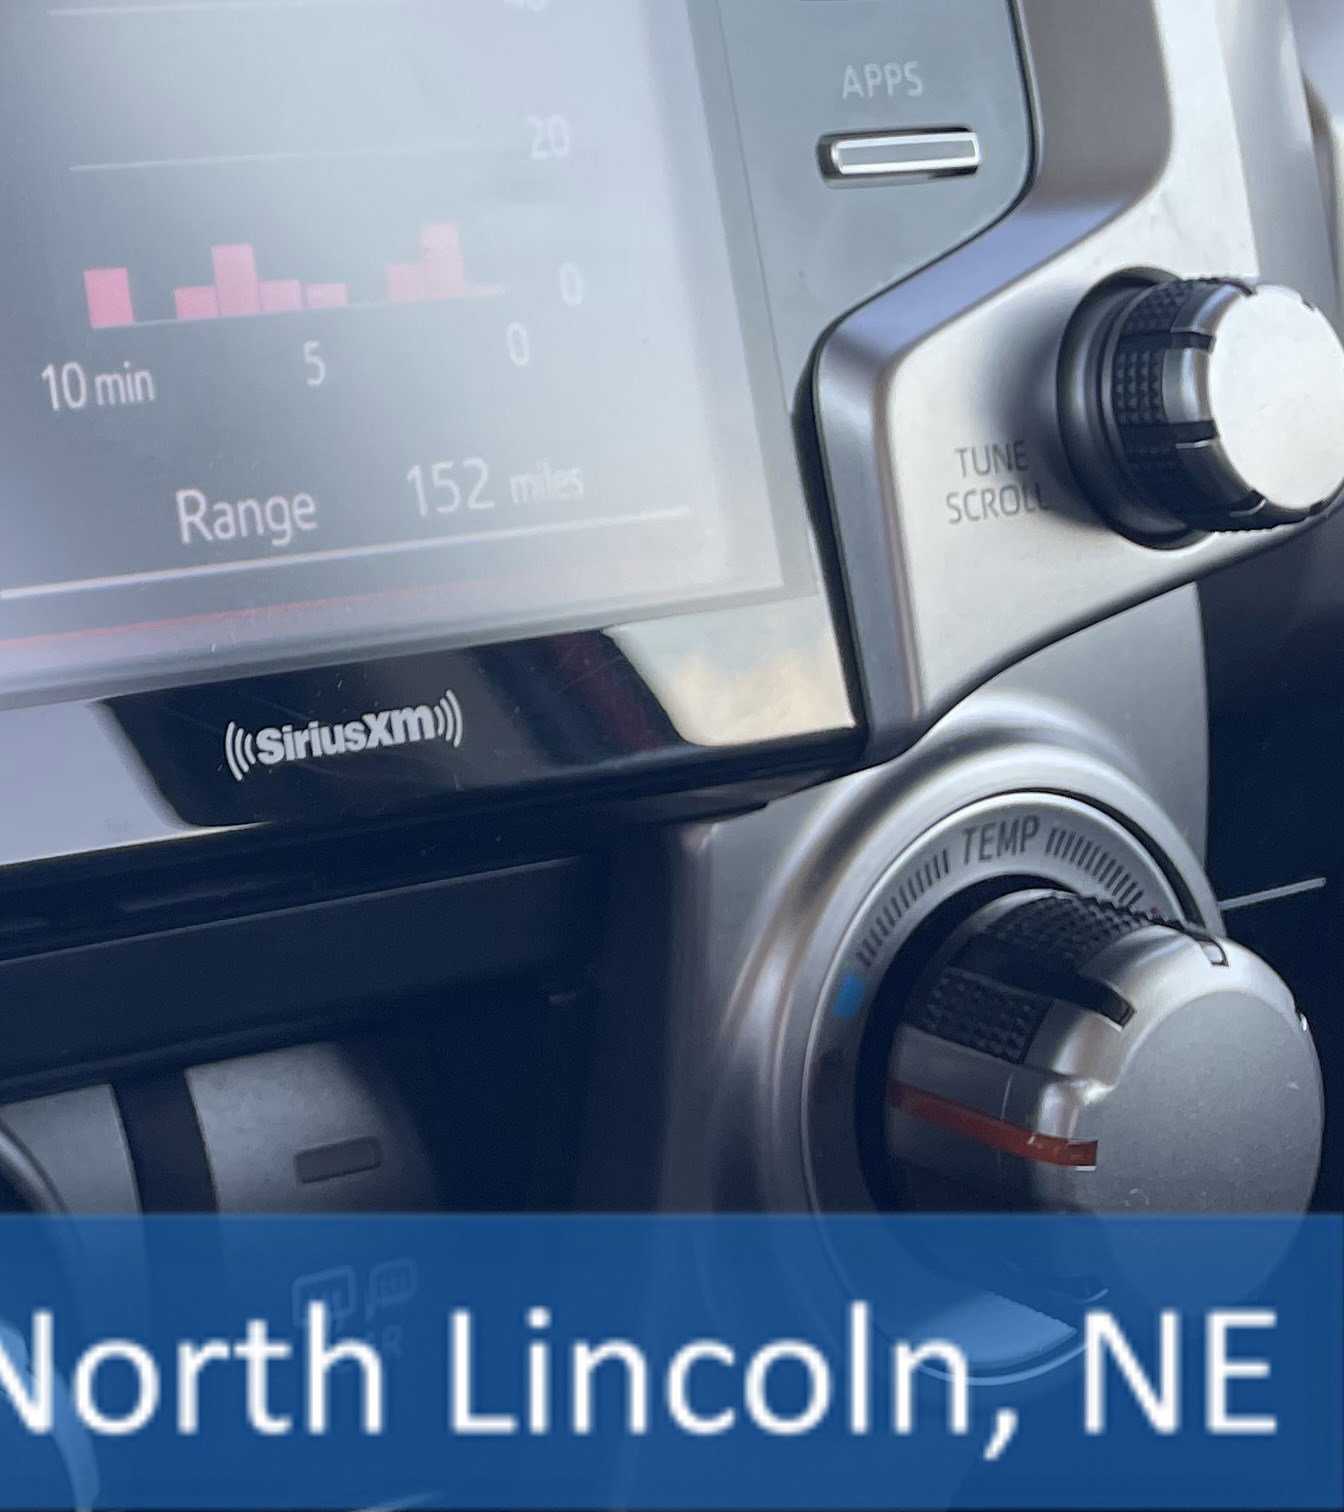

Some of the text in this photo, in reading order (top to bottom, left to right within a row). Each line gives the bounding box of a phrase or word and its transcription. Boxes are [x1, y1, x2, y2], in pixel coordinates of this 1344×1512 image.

[842, 61, 924, 100] APPS
[526, 113, 571, 160] 20
[558, 261, 584, 307] 0
[302, 340, 327, 387] 5
[505, 321, 530, 367] 0
[40, 360, 155, 411] 10 min
[953, 438, 1030, 479] TUNE
[175, 456, 586, 549] Range 152 miles
[945, 482, 1053, 525] SCROLL
[961, 814, 1041, 865] TEMP
